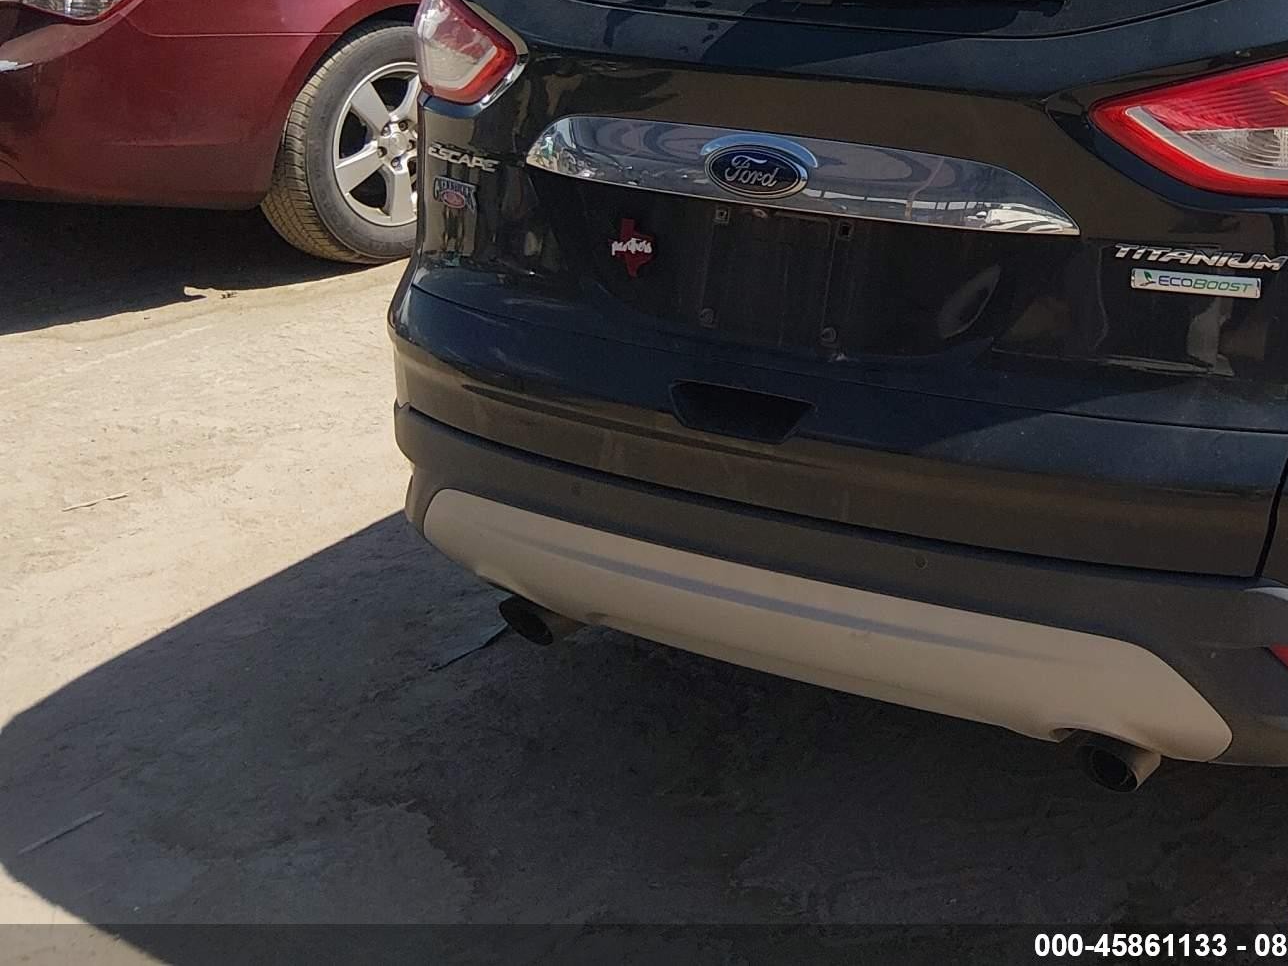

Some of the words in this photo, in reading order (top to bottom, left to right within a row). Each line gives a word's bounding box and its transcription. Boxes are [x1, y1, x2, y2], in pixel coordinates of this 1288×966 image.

[428, 141, 501, 173] ESCAPE
[724, 154, 778, 188] Ford
[1114, 242, 1288, 272] TITANIUM
[1158, 275, 1253, 293] ECOBOOST
